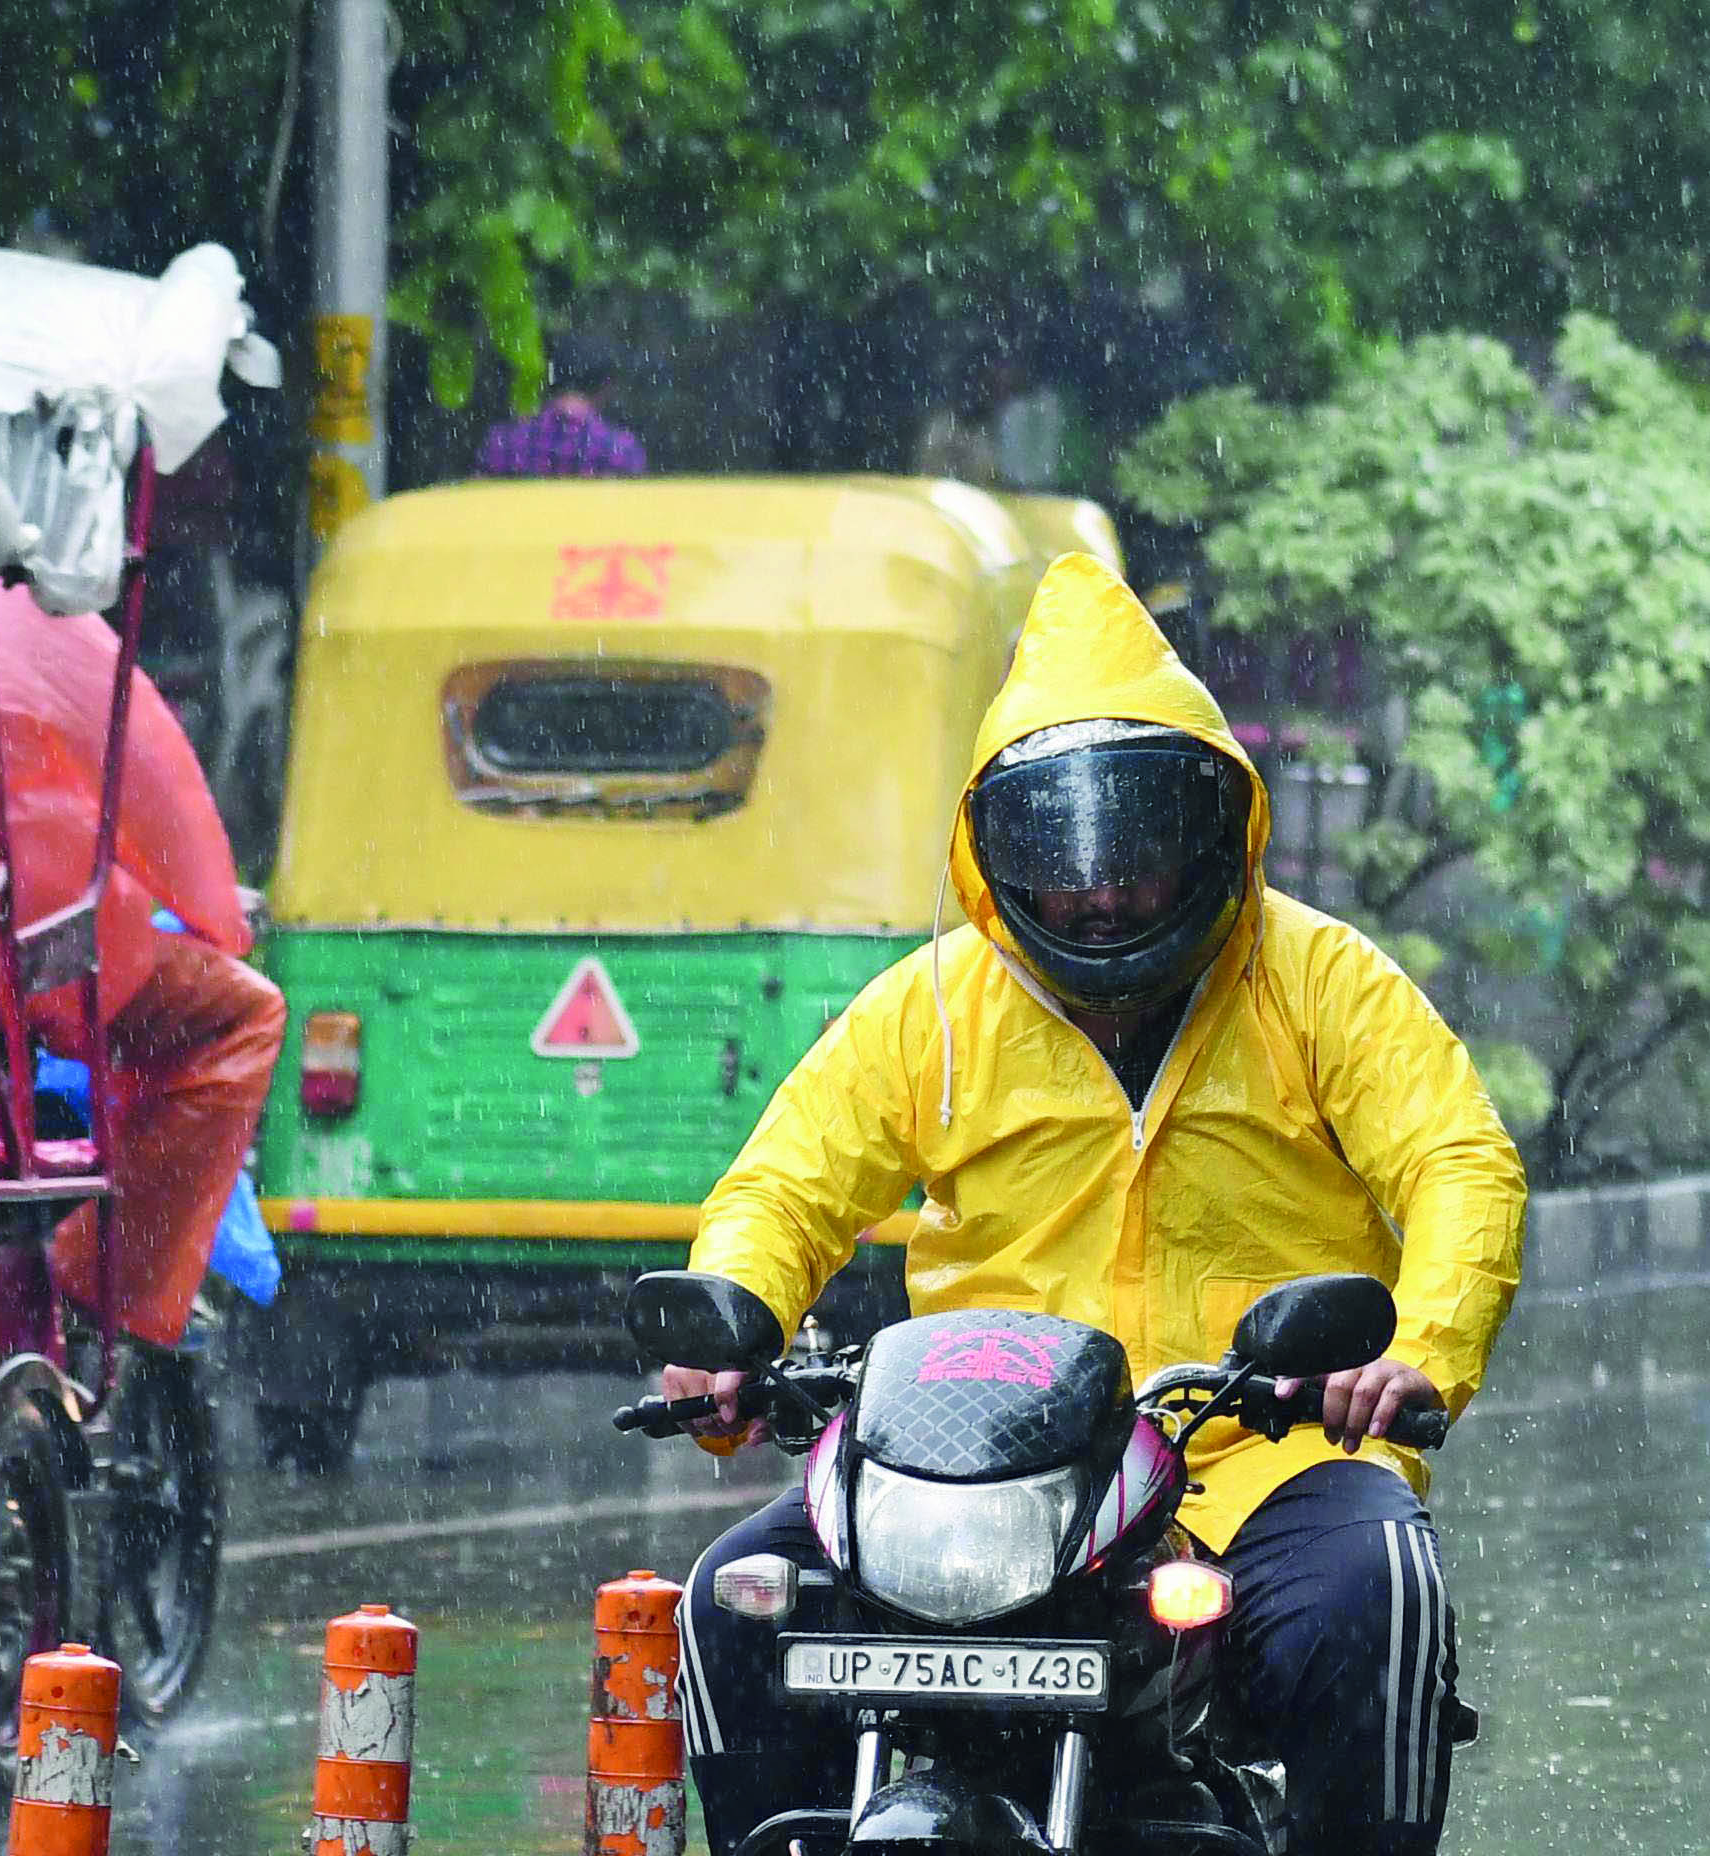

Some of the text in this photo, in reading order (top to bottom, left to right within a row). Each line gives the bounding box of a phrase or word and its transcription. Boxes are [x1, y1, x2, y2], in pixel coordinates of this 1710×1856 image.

[804, 1674, 824, 1684] IND
[828, 1651, 1096, 1689] UP 75AC 1436
